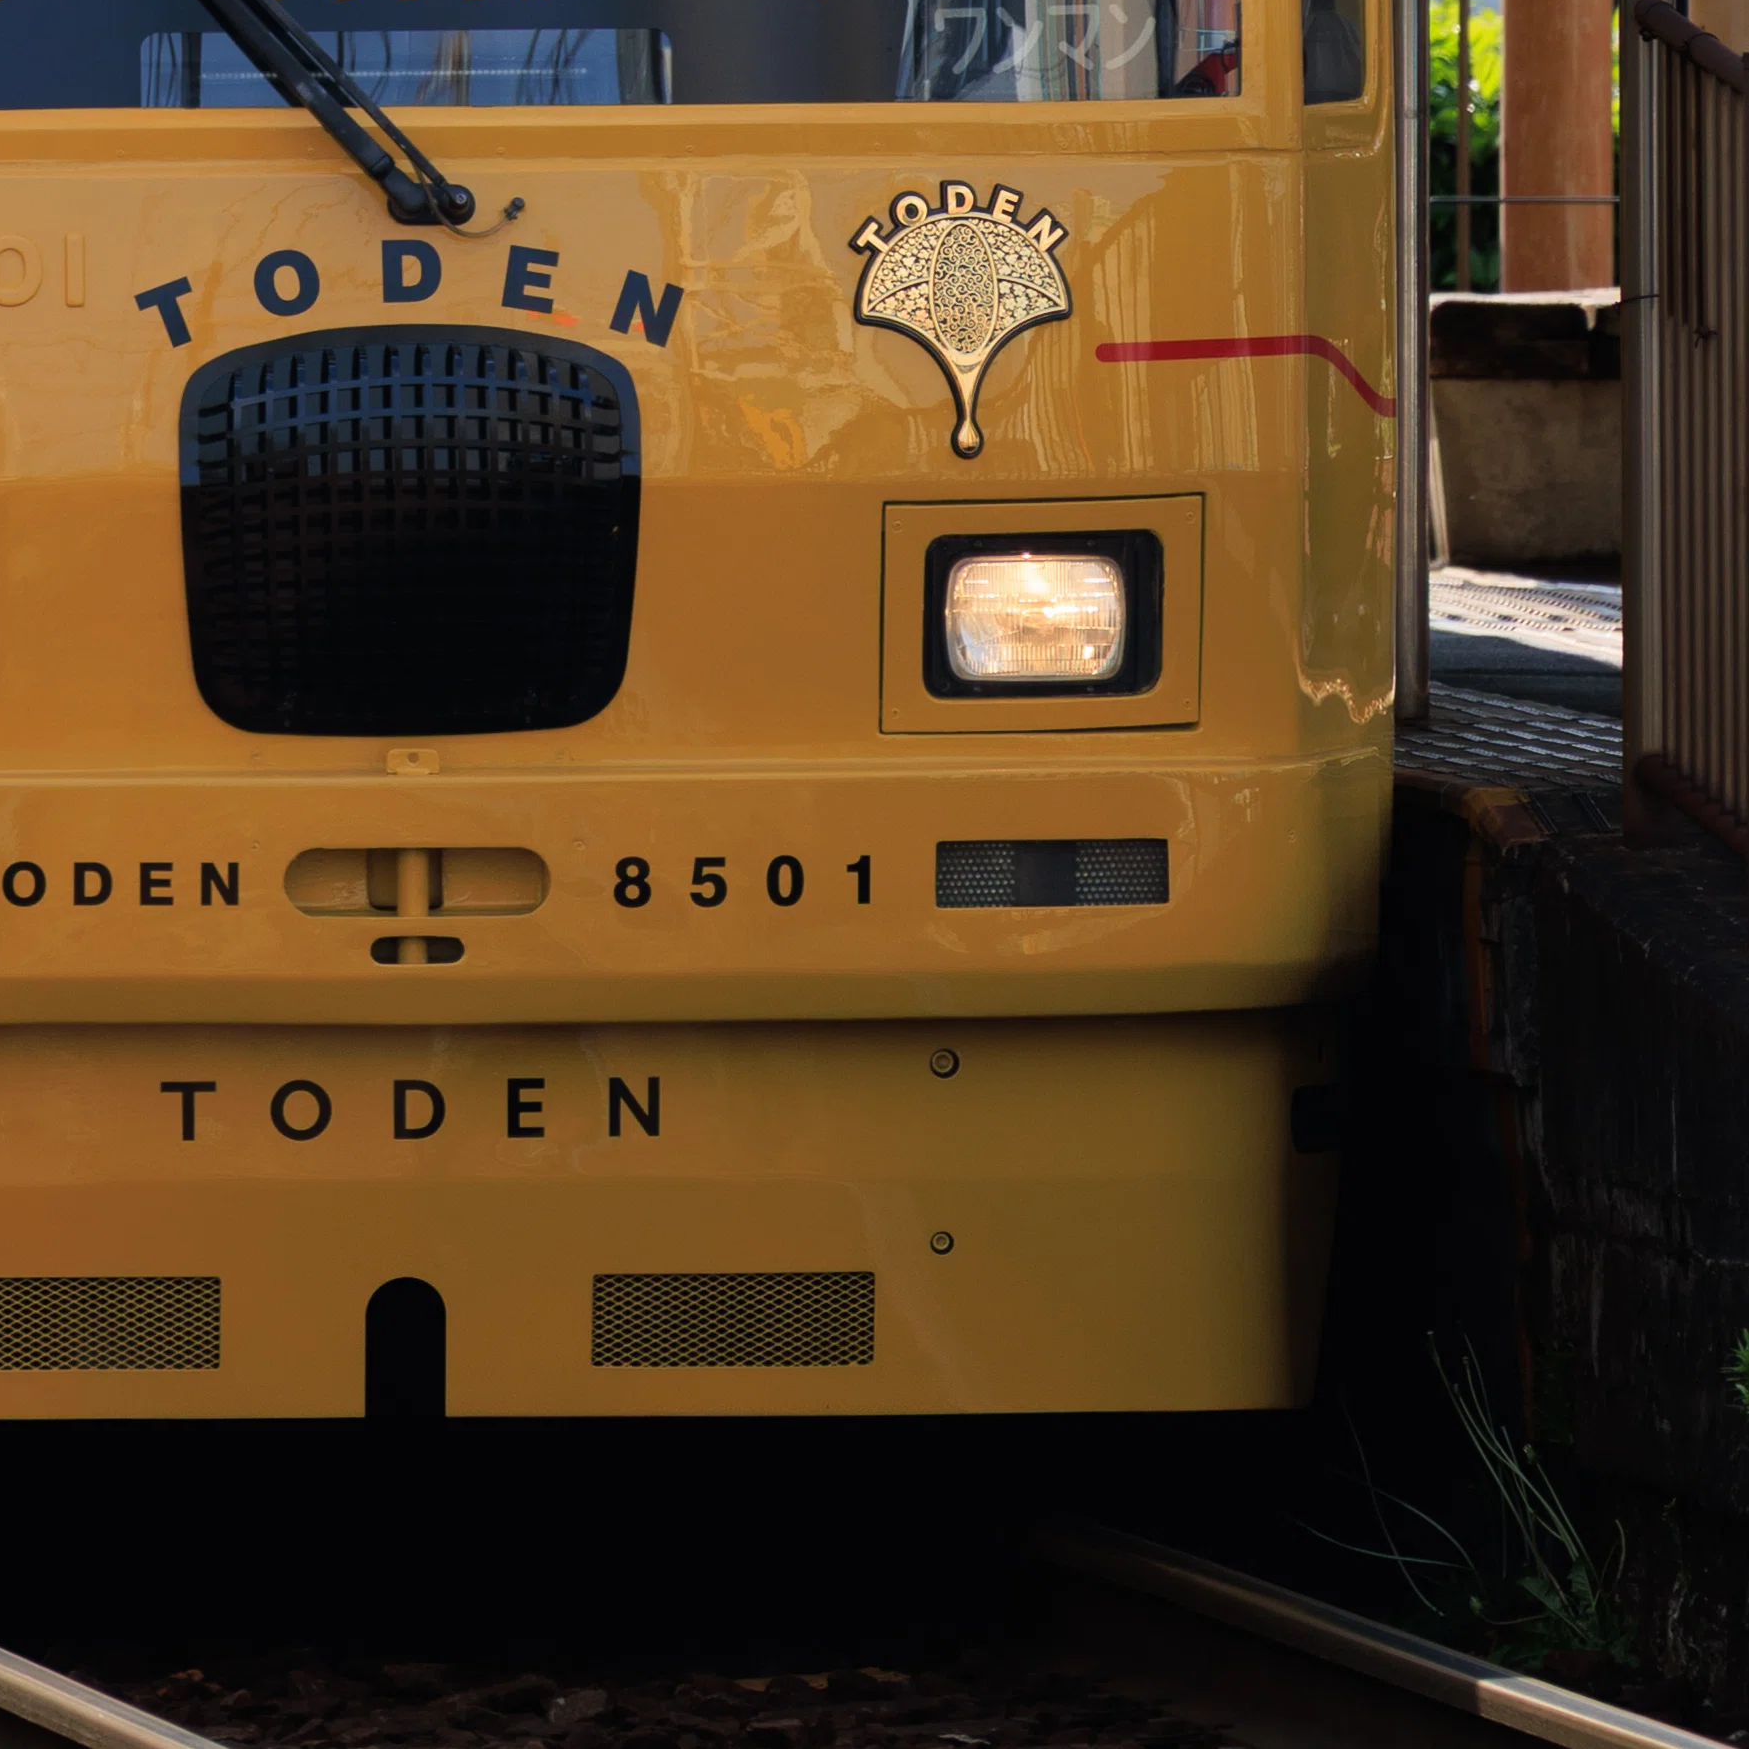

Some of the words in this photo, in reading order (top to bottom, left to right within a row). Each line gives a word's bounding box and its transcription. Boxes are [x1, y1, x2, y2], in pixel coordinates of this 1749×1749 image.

[934, 3, 1156, 75] ワンマン
[853, 183, 1066, 254] TODEN
[134, 238, 686, 349] TODEN
[612, 855, 873, 908] 8501
[160, 1075, 662, 1142] TODEN
